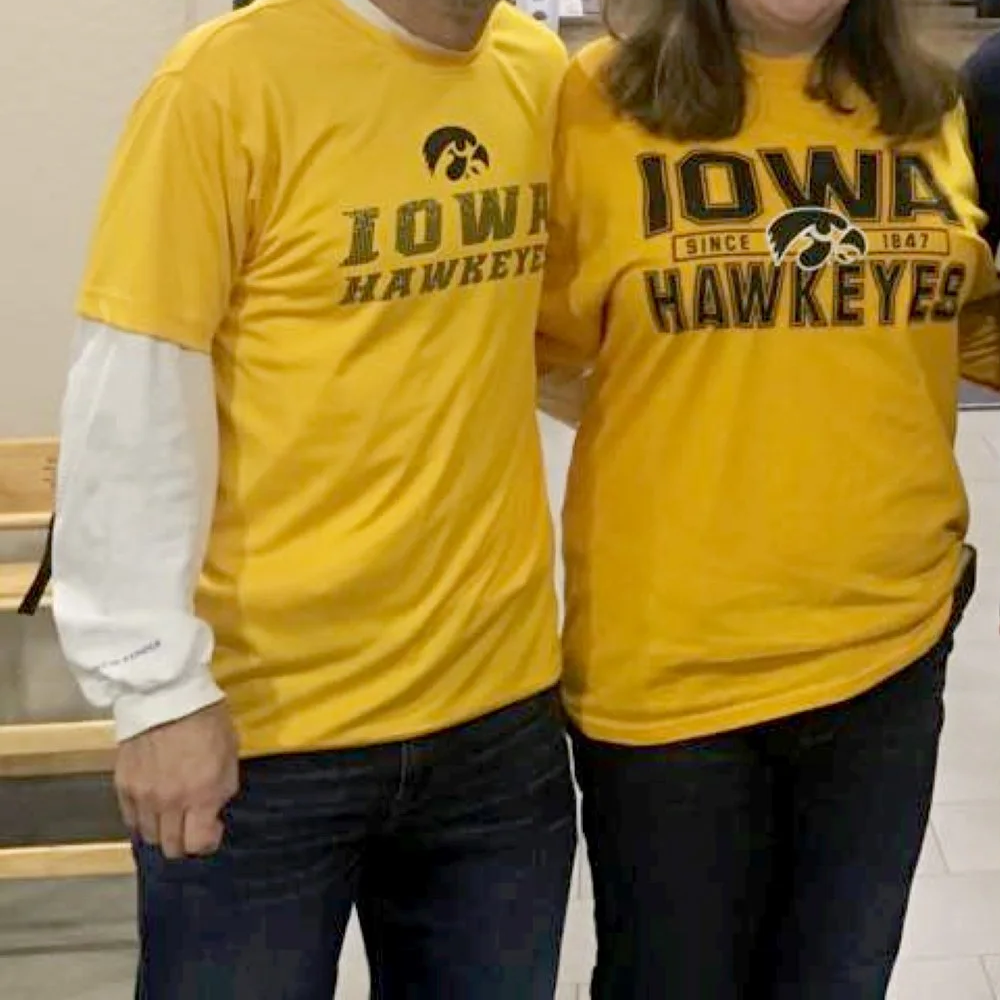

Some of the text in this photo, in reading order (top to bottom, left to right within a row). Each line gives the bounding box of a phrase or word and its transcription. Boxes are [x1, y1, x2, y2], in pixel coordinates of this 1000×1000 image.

[636, 145, 964, 239] IOWA
[339, 244, 545, 305] HAWKEYE
[686, 231, 930, 254] SINCE 1847
[643, 260, 966, 333] HAWKEYES
